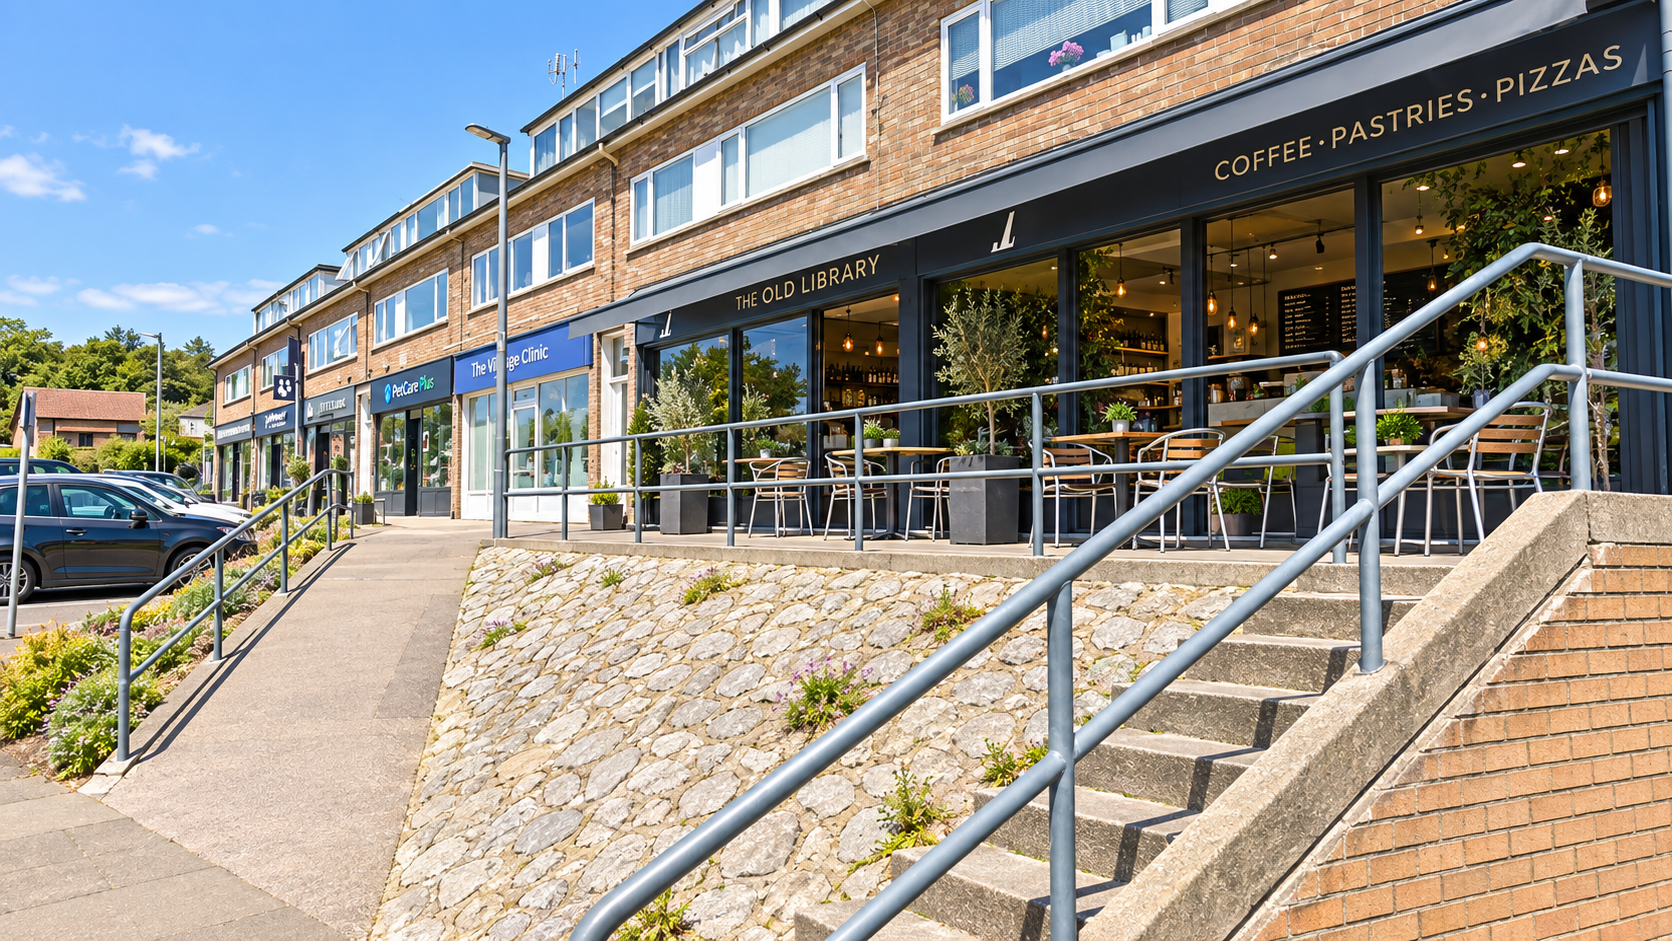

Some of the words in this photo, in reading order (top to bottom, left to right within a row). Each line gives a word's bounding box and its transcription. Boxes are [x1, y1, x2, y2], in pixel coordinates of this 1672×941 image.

[1214, 135, 1312, 181] COFFEE
[1332, 88, 1474, 149] PASTRIES
[1496, 45, 1623, 103] PIZZAS
[735, 291, 758, 311] THE
[762, 280, 795, 304] OLD
[801, 254, 880, 294] LIBRARY
[471, 361, 486, 378] The
[521, 343, 549, 364] Clinic
[392, 380, 419, 399] PetCare
[419, 374, 435, 392] Plus
